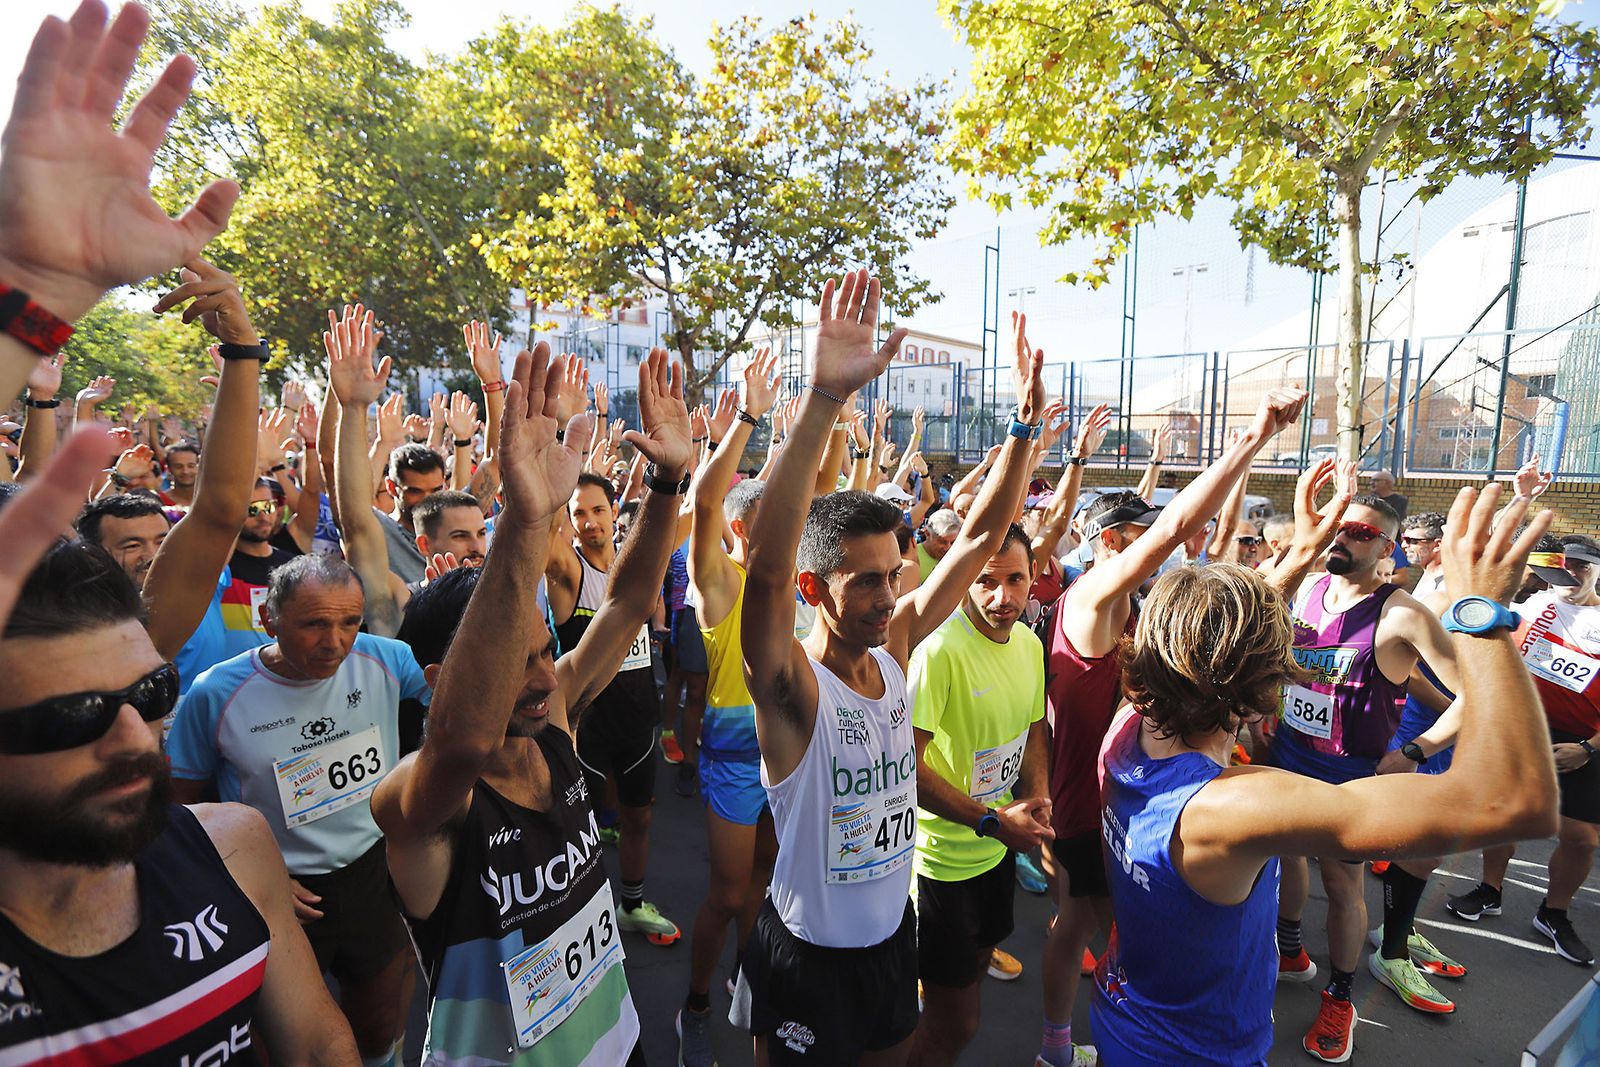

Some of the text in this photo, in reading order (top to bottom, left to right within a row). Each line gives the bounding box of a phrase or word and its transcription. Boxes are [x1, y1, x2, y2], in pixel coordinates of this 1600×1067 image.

[1551, 658, 1590, 682] 662
[1293, 698, 1329, 726] 584
[324, 729, 351, 743] Hotels
[300, 767, 324, 785] HUELVA
[328, 747, 381, 790] 663
[832, 745, 916, 797] bathco
[884, 793, 908, 808] ENRIQUE
[840, 814, 872, 832] 35 VUELTA
[844, 823, 873, 840] A HUELVA
[874, 807, 914, 852] 470
[538, 902, 549, 912] de
[564, 909, 613, 981] 613
[519, 949, 560, 985] 35 VUELTA
[527, 957, 562, 991] A HUELVA
